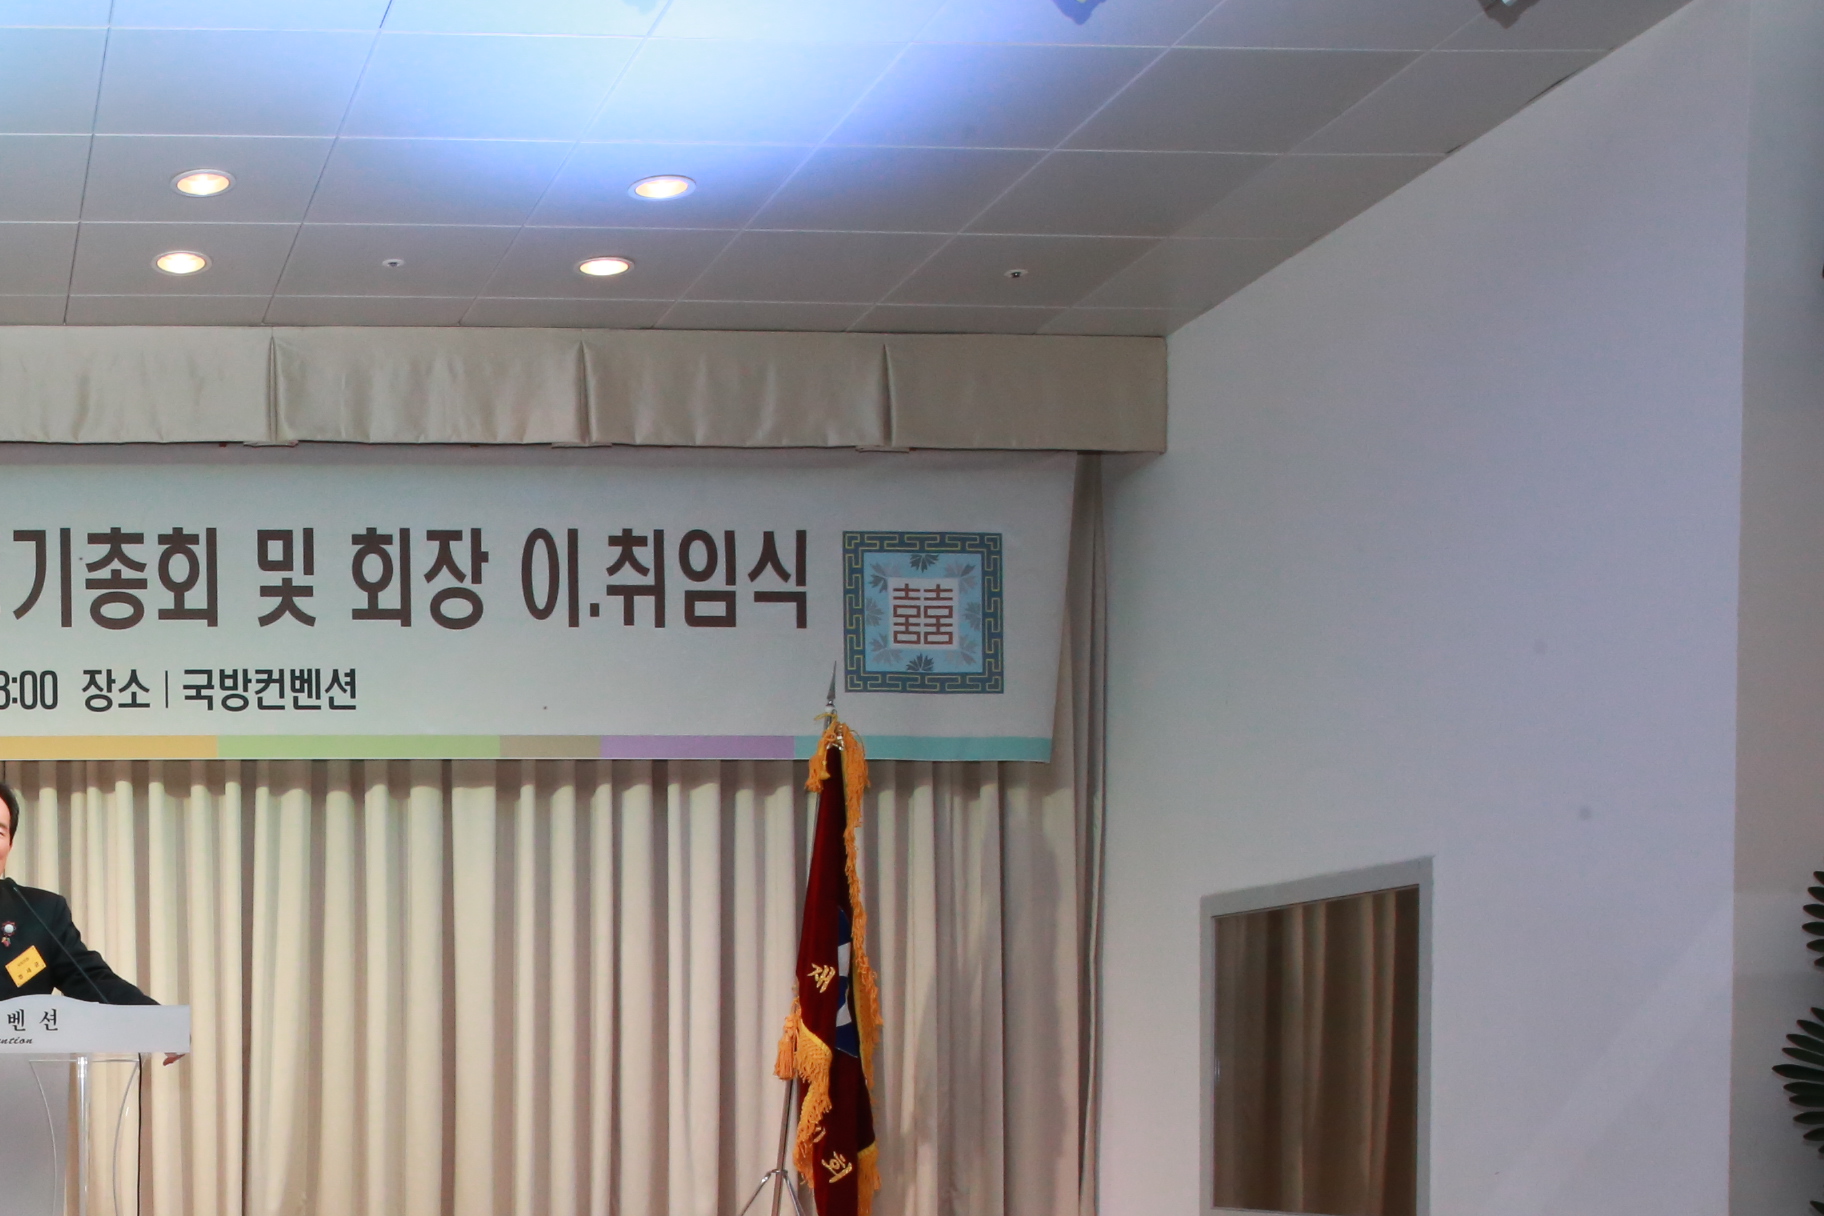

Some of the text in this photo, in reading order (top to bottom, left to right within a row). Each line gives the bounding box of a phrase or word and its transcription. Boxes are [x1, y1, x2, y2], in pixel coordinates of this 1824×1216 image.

[257, 528, 316, 627] 및
[352, 527, 489, 629] 회장
[521, 528, 807, 629] 이.취임식
[82, 669, 150, 712] 장소
[183, 669, 356, 711] 국방컨벤션
